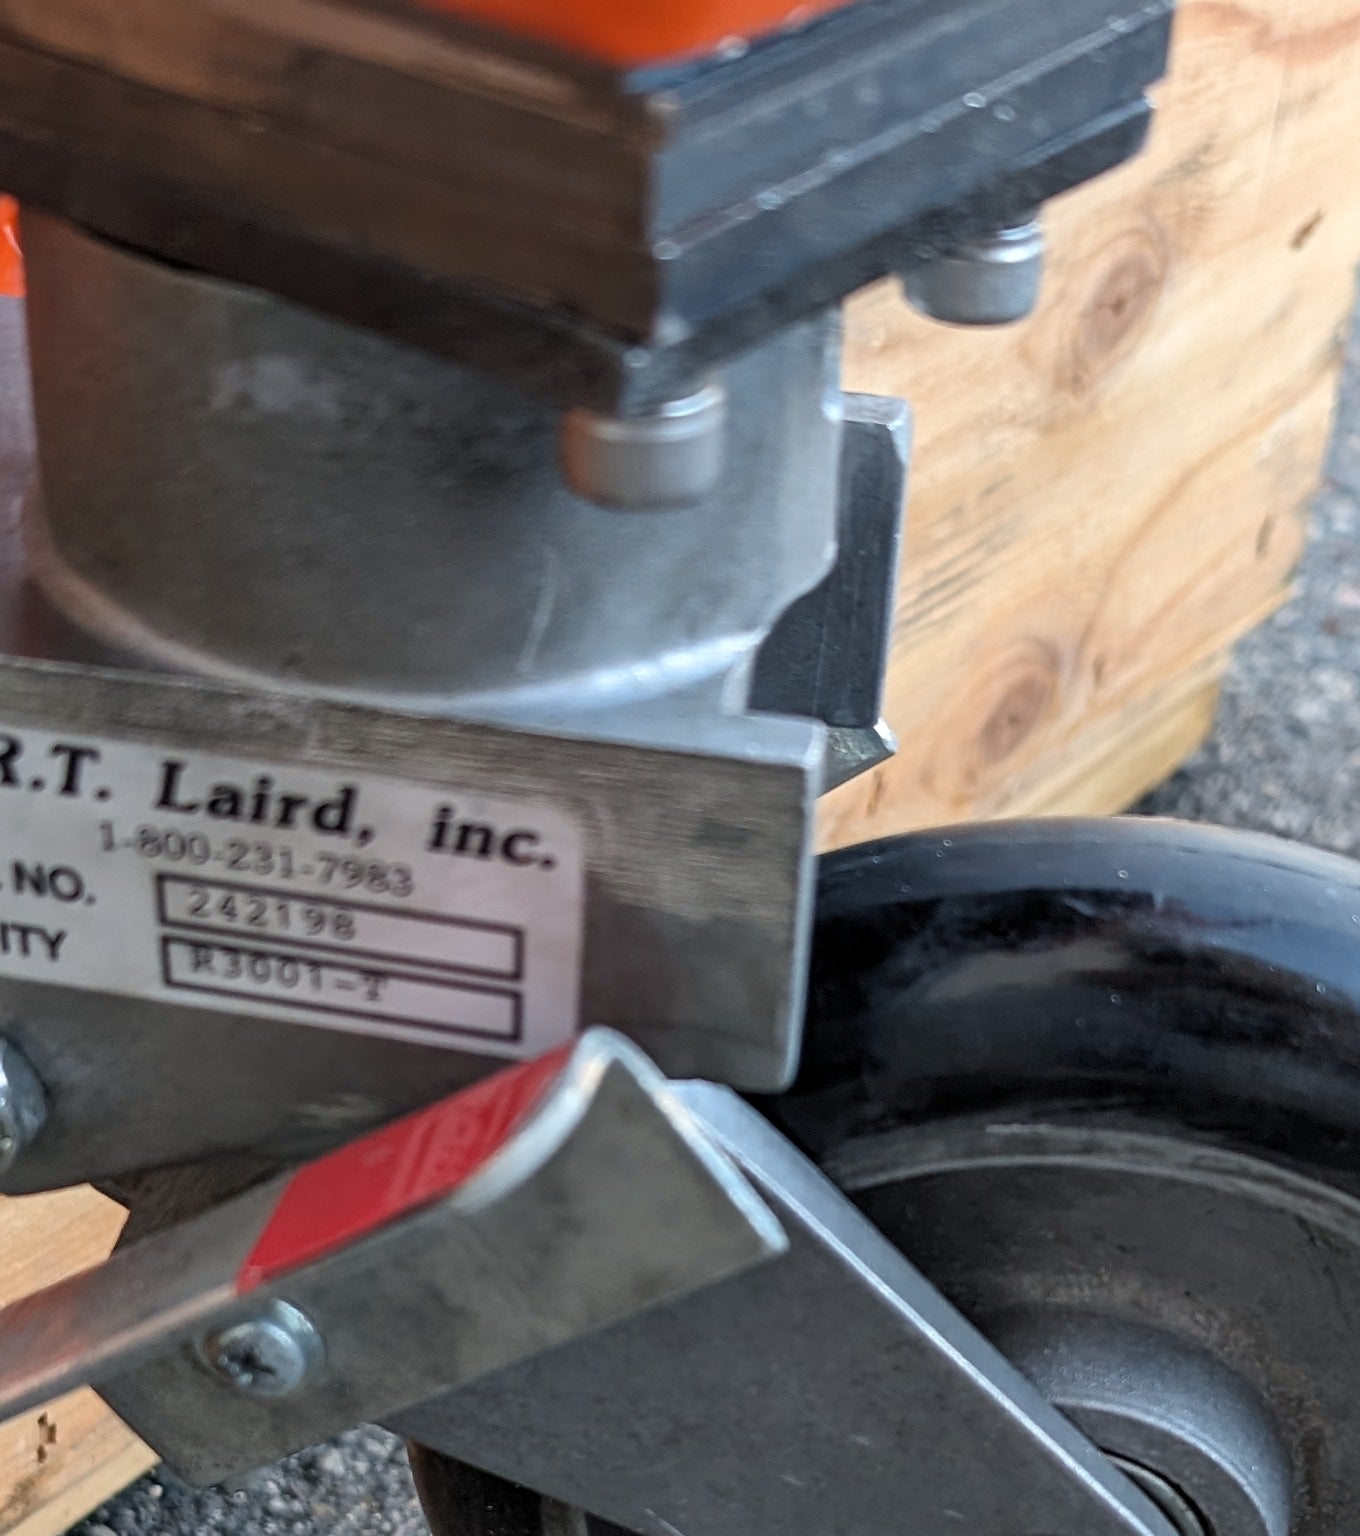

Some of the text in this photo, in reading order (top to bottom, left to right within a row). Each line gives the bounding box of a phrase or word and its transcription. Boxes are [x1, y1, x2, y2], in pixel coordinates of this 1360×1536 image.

[154, 758, 376, 849] Laird,
[425, 803, 558, 872] inc.
[99, 818, 415, 898] 1-800-231-7983
[11, 859, 98, 906] NO.
[188, 886, 357, 941] 242198
